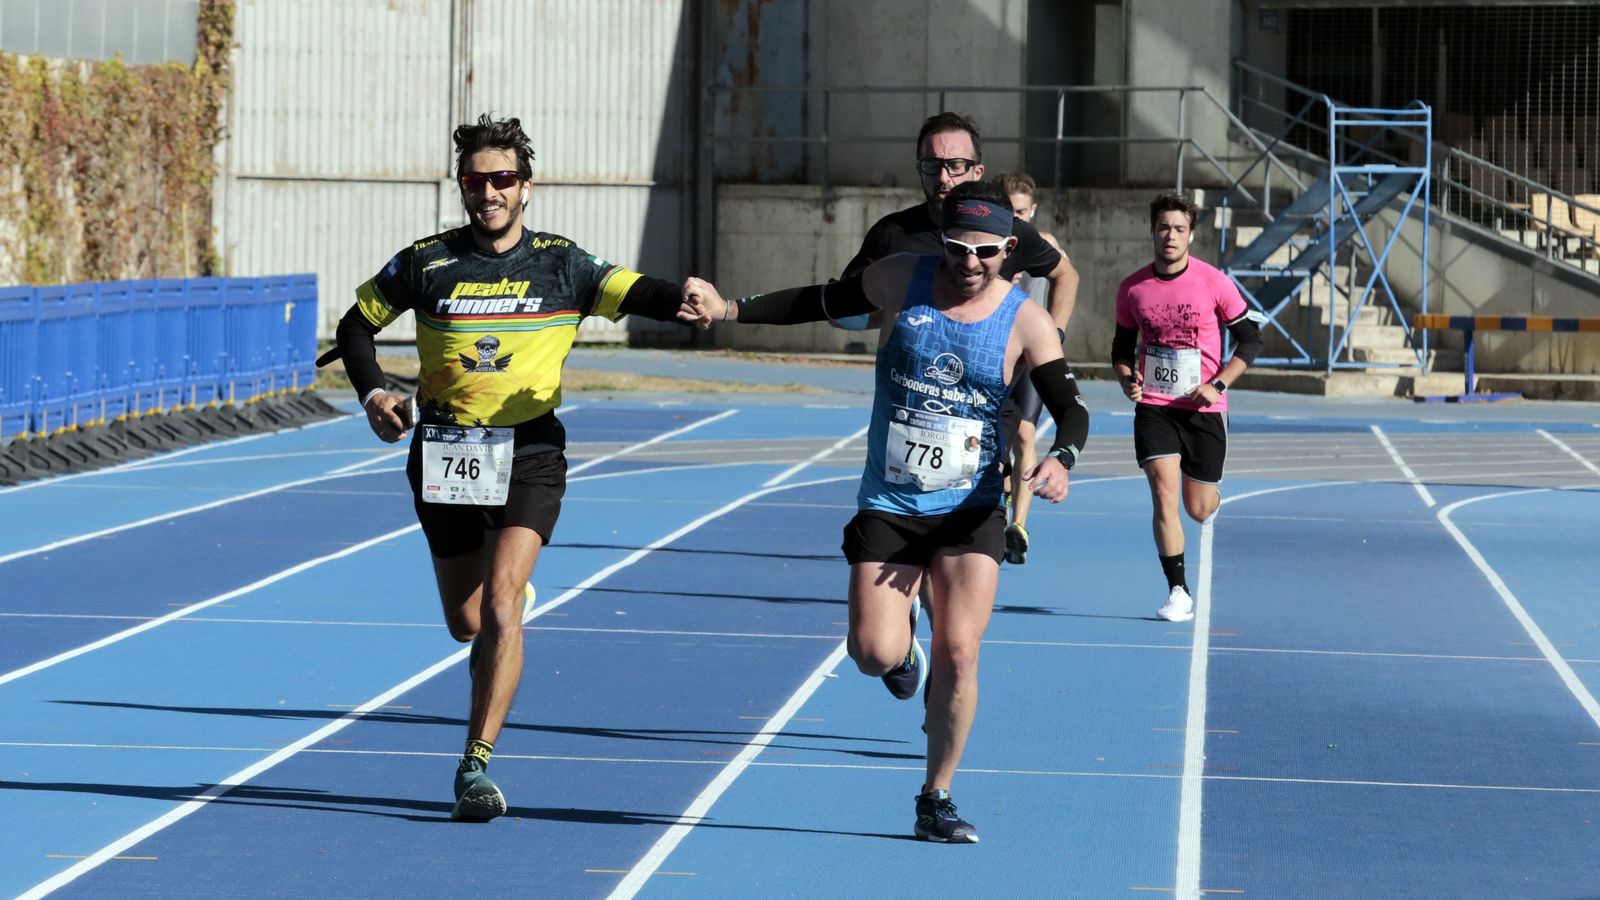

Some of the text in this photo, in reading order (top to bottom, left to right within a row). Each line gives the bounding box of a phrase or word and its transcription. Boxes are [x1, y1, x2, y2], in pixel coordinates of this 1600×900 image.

[450, 277, 531, 301] peaky
[435, 297, 543, 315] runners
[890, 367, 941, 397] Carboneras
[941, 387, 966, 404] sabe
[1154, 366, 1179, 384] 626
[920, 430, 949, 441] JORGE
[443, 443, 494, 454] JUAN DAVID
[904, 440, 944, 470] 778
[441, 456, 481, 480] 746
